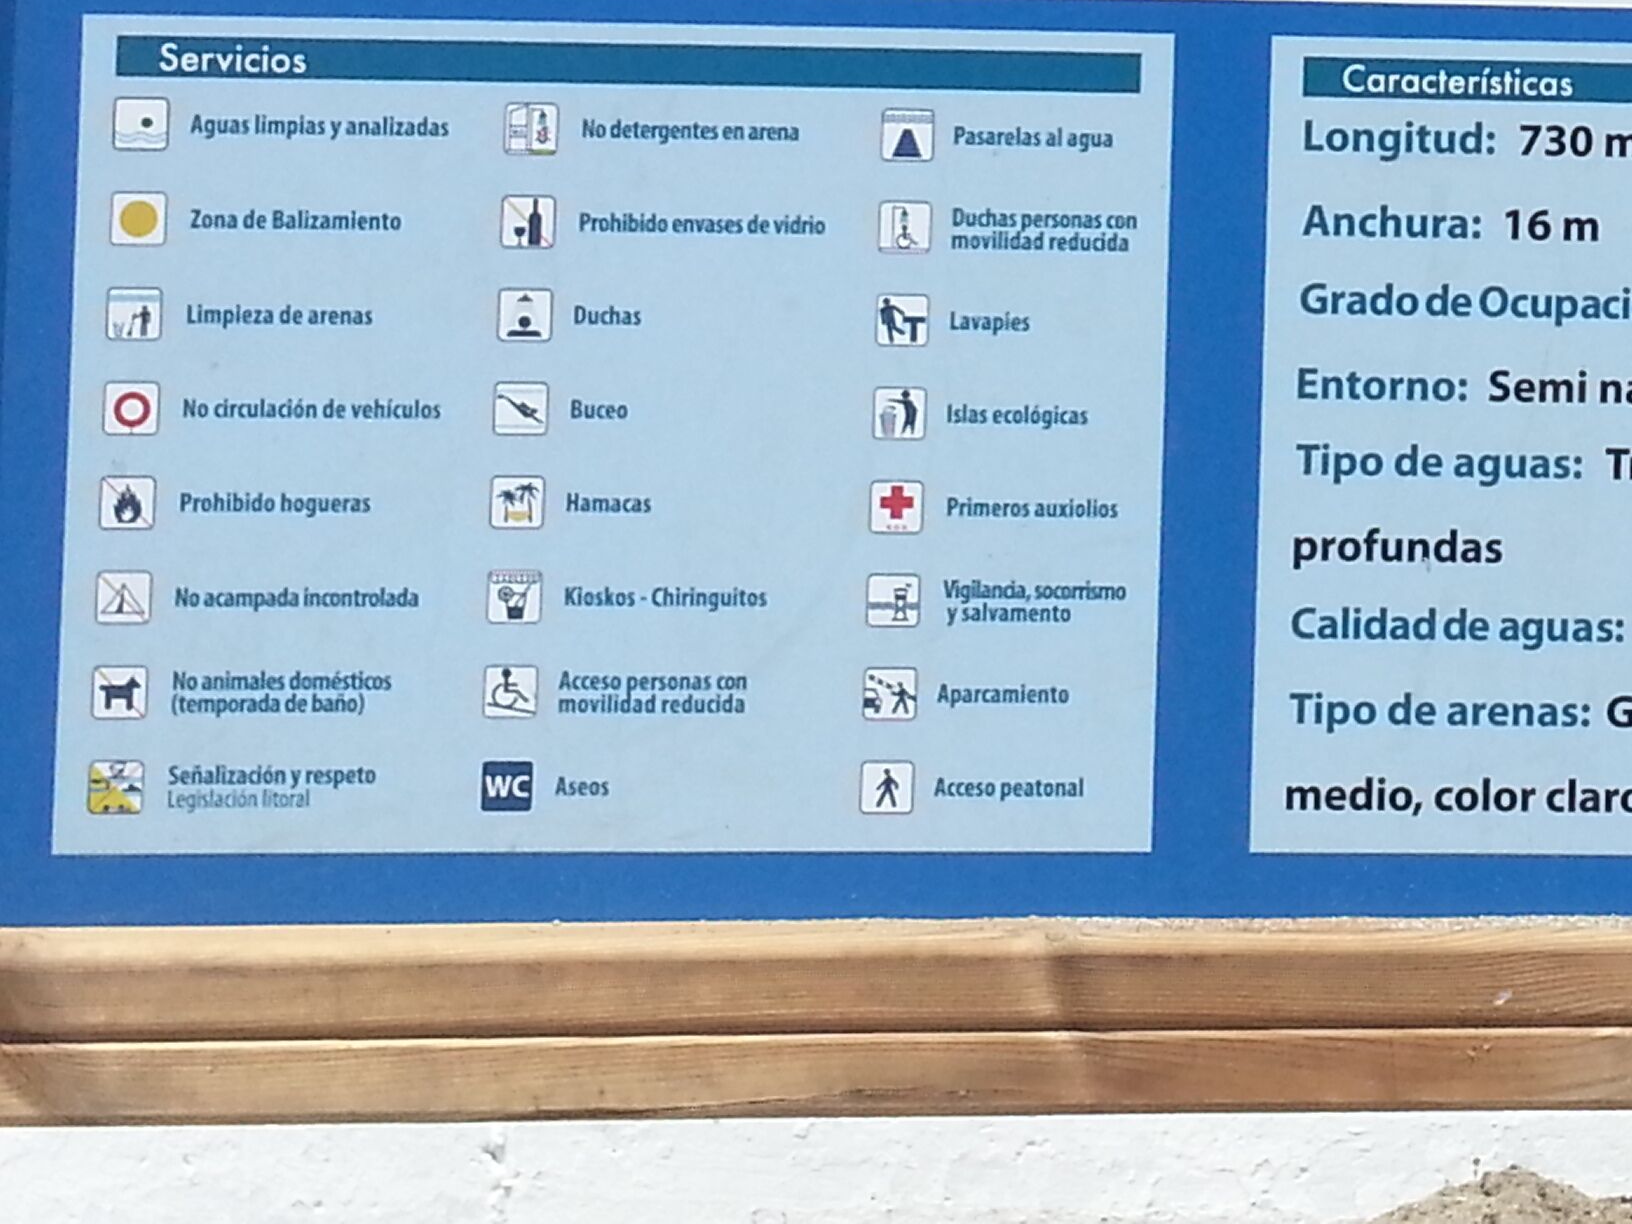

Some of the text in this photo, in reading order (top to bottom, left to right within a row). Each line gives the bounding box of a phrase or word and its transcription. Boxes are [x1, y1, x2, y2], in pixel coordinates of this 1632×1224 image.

[159, 42, 306, 73] Servicios
[1342, 65, 1574, 98] Características
[190, 114, 449, 140] Aguas limpias y analizadas
[953, 126, 1113, 152] Pasarelas al agua
[1304, 119, 1495, 161] Longitud:
[1519, 124, 1592, 157] 730
[190, 208, 401, 230] Zona de Balizamiento
[579, 212, 825, 234] Prohibido envases de vidrio
[1300, 282, 1418, 315] Grado
[1425, 283, 1472, 316] de
[186, 303, 372, 329] Limpieza de arenas
[574, 305, 641, 325] Duchas
[1297, 367, 1467, 401] Entorno:
[1488, 369, 1586, 403] Semi
[570, 399, 628, 419] Buceo
[179, 492, 370, 518] Prohibido hogueras
[566, 492, 651, 513] Hamacas
[946, 496, 1118, 518] Primeros auxiolios
[1293, 527, 1502, 569] profundas
[174, 587, 419, 612] No acampada incontrolada
[1291, 606, 1436, 640] Calidad
[1443, 607, 1489, 640] de
[1499, 617, 1623, 650] aguas:
[937, 683, 1069, 708] Aparcamiento
[168, 764, 376, 792] Señalización y respeto
[484, 775, 531, 800] WC
[555, 776, 609, 796] Aseos
[934, 777, 1083, 801] Acceso peatonal
[167, 786, 309, 813] Legislación litoral
[1286, 776, 1422, 816] medio,
[1434, 777, 1536, 812] color
